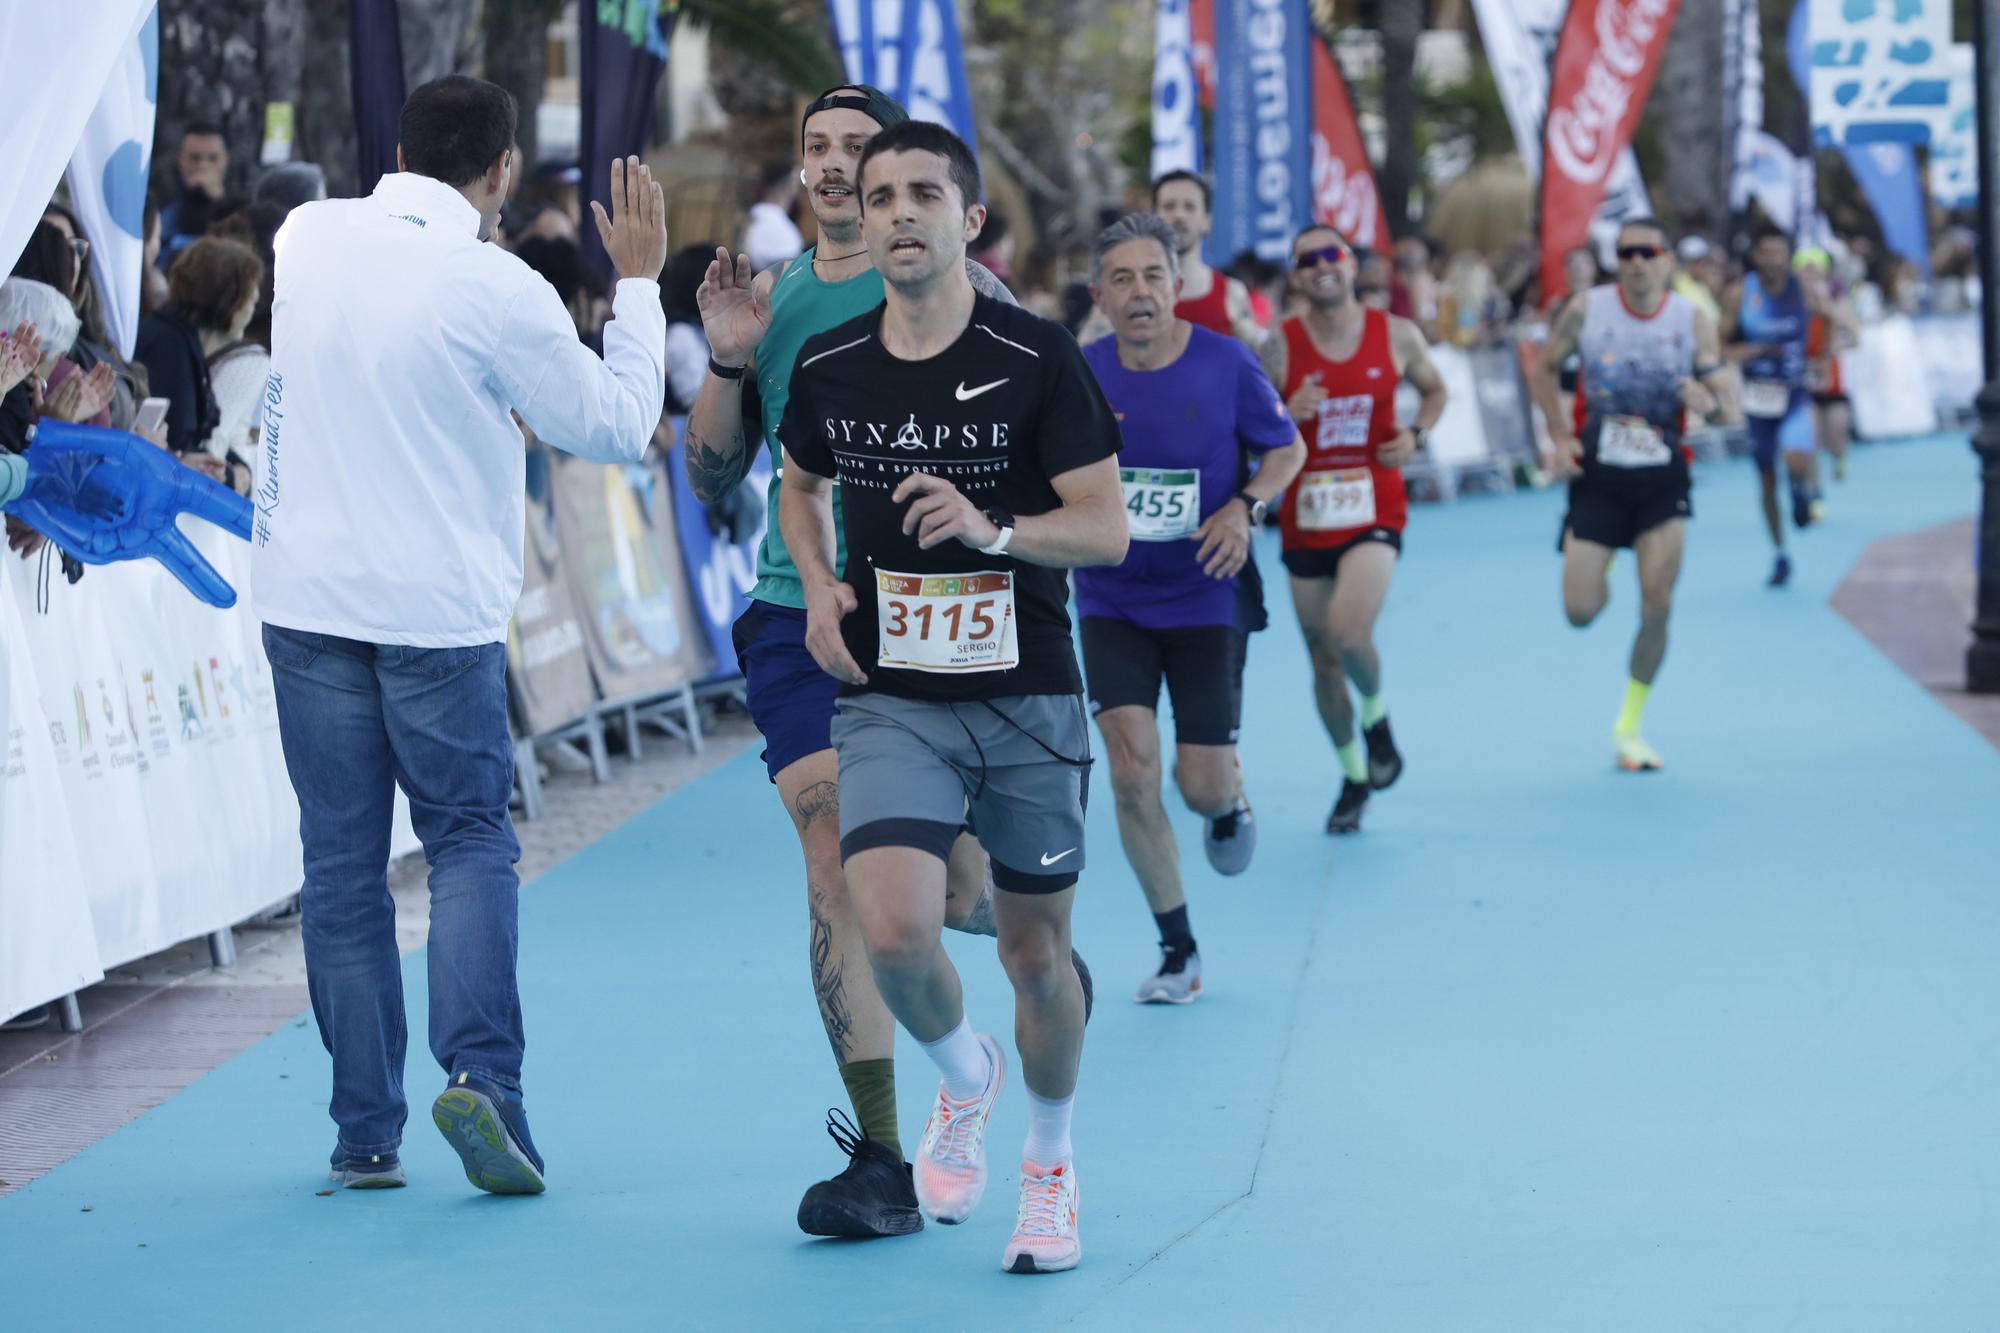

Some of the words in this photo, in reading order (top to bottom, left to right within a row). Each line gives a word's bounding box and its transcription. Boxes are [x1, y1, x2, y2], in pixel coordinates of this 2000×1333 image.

[878, 463, 886, 473] &
[893, 464, 938, 475] SPORT
[947, 460, 1009, 475] SCIENCE
[966, 479, 996, 490] 2012
[1121, 489, 1185, 518] 455
[886, 599, 995, 641] 3115
[957, 641, 996, 654] SERGIO
